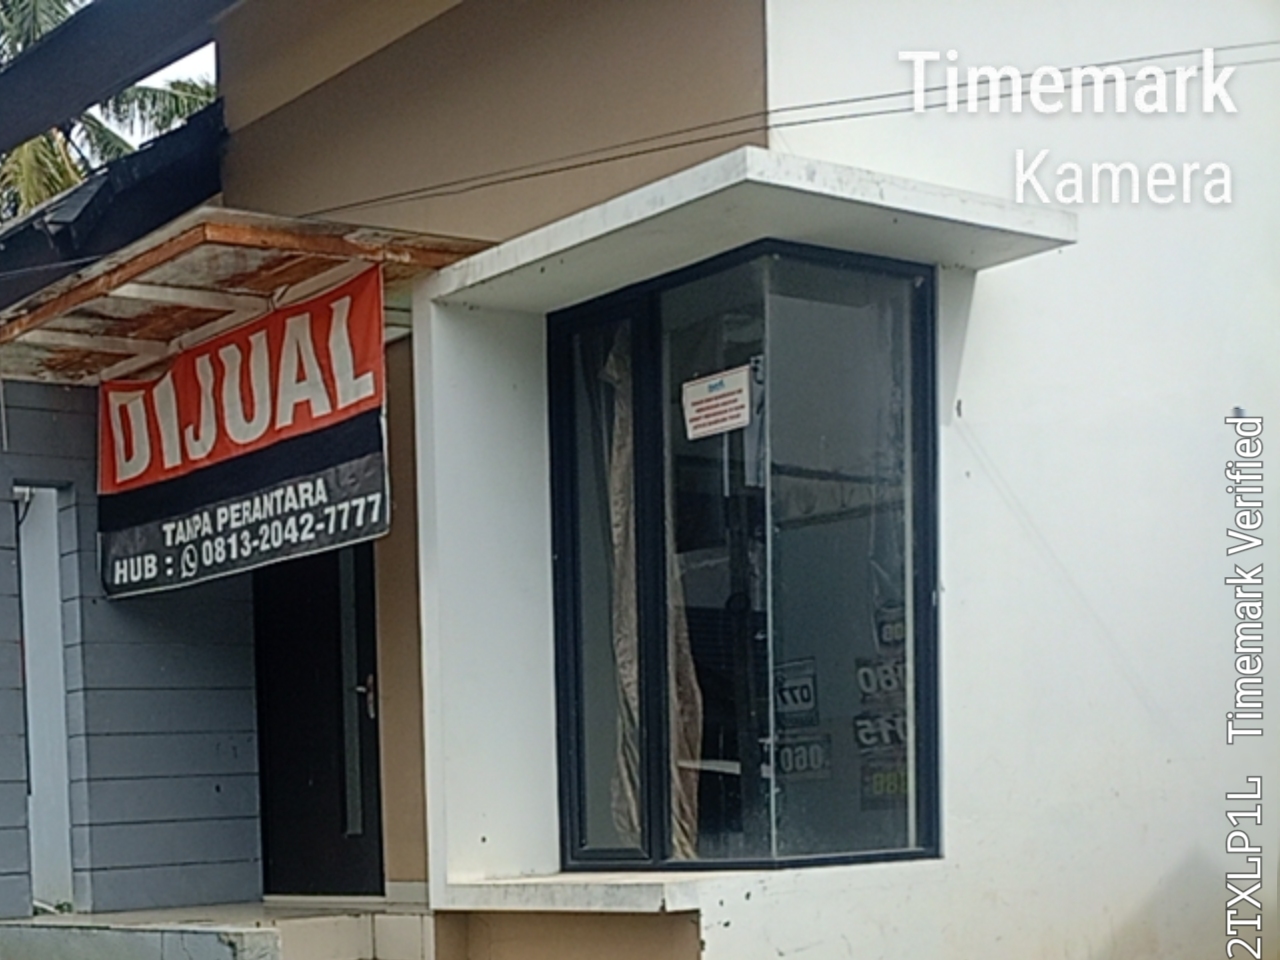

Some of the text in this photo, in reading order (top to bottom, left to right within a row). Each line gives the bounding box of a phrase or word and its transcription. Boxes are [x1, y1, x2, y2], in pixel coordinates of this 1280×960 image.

[107, 295, 375, 484] DIJUAL
[114, 553, 158, 585] HUB
[201, 492, 382, 567] 0813-2042-7777
[162, 477, 328, 547] TANPA PERANTARA
